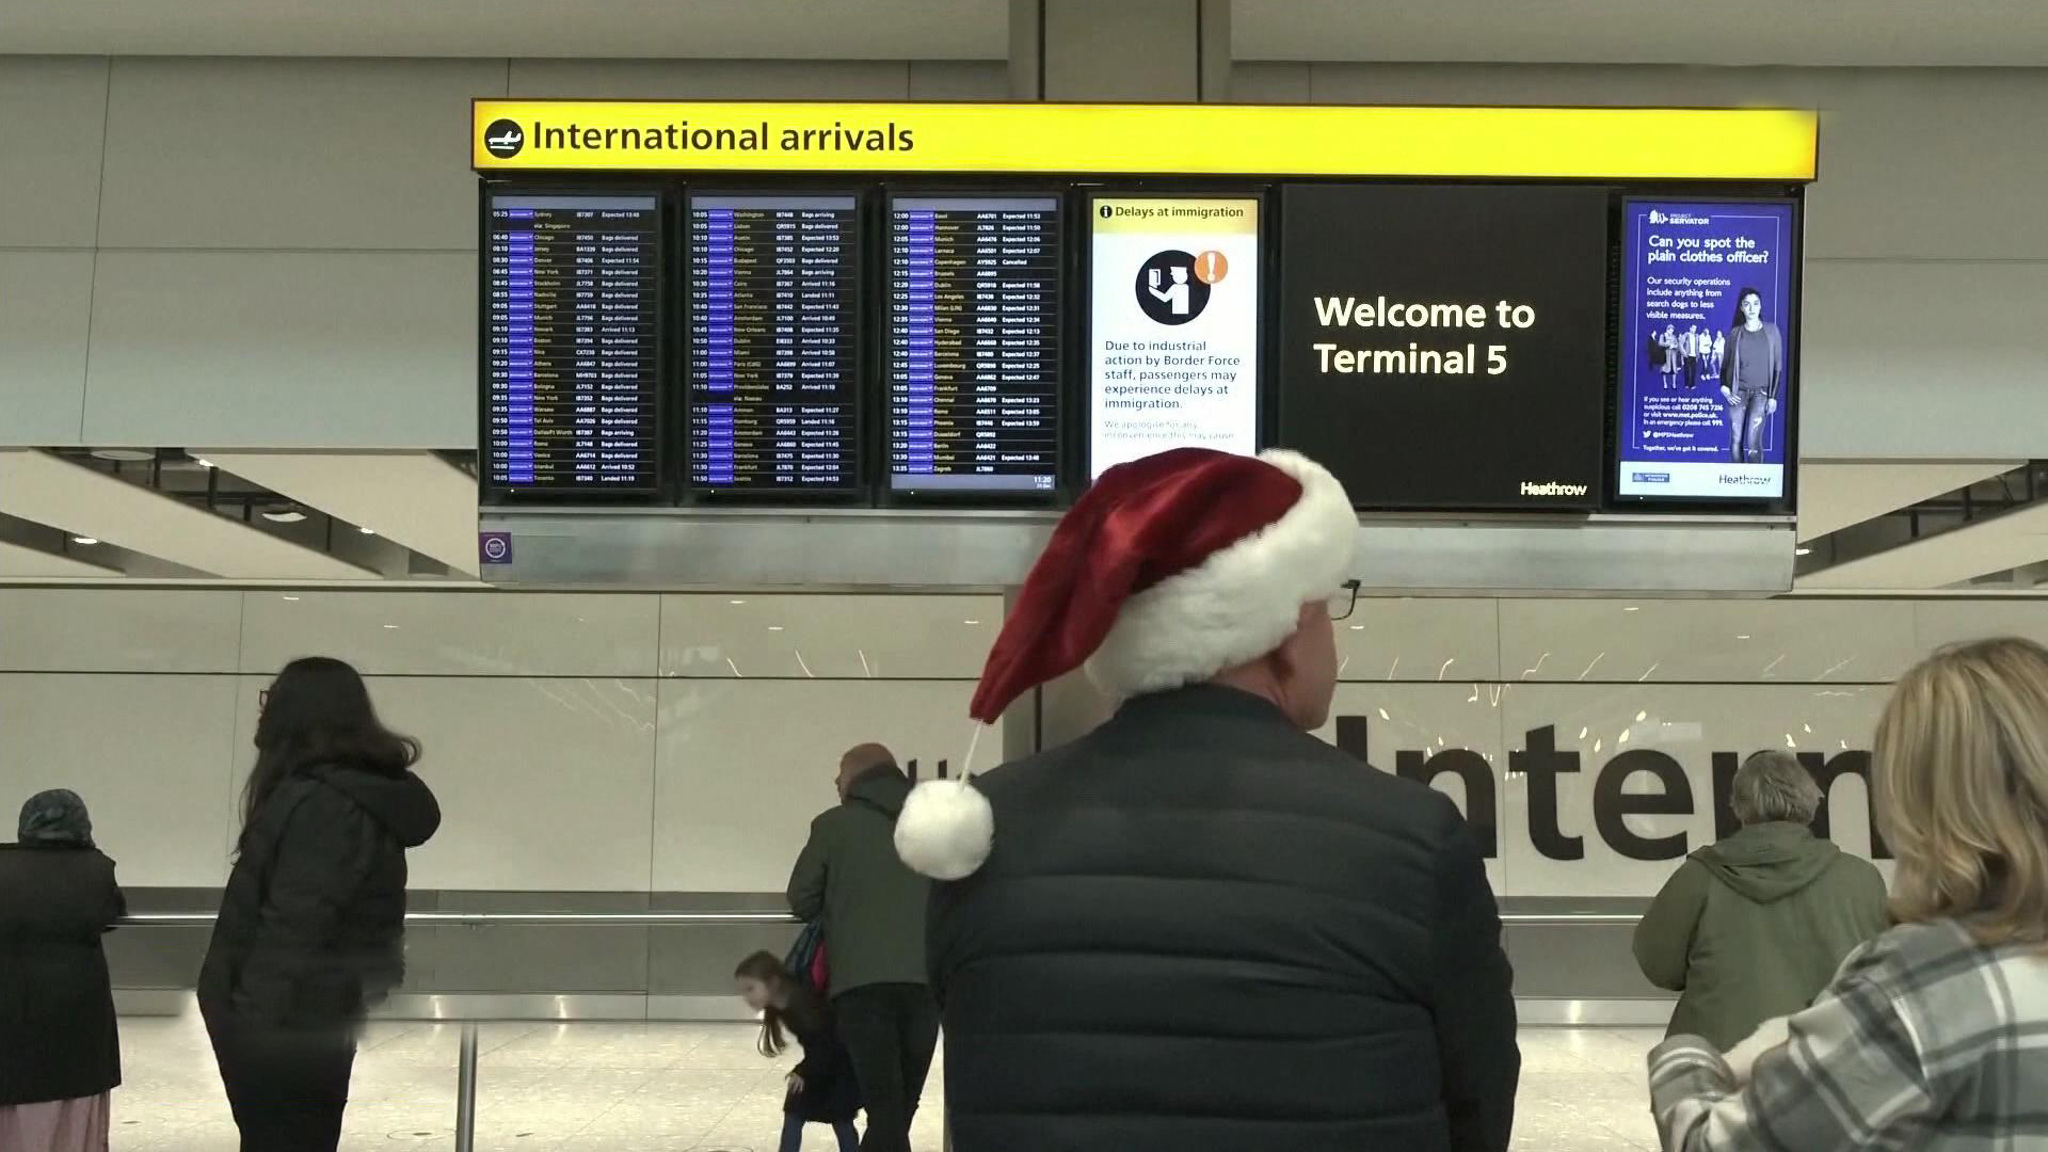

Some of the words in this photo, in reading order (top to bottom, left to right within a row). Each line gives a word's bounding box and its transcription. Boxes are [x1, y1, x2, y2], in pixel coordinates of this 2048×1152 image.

[534, 121, 768, 150] International
[781, 122, 914, 150] arrivals
[1115, 206, 1154, 219] Delays
[1157, 208, 1169, 216] at
[1171, 206, 1244, 219] immigration
[1648, 235, 1673, 248] Can
[1676, 238, 1700, 250] you
[1704, 237, 1732, 250] spot
[1735, 236, 1756, 248] the
[1648, 249, 1676, 264] plain
[1680, 250, 1723, 262] clothes
[1726, 250, 1769, 264] officer?
[1647, 276, 1662, 285] Our
[1664, 277, 1692, 286] security
[1694, 277, 1731, 287] operations
[1646, 288, 1672, 296] include
[1674, 288, 1704, 298] anything
[1705, 288, 1722, 297] from
[1646, 300, 1670, 308] search
[1671, 300, 1688, 310] dogs
[1700, 300, 1714, 308] less
[1314, 296, 1486, 328] Welcome
[1496, 300, 1536, 328] to
[1646, 311, 1668, 319] visible
[1105, 340, 1130, 350] Due
[1133, 342, 1145, 350] to
[1149, 340, 1206, 350] industrial
[1105, 355, 1142, 366] action
[1146, 355, 1160, 367] by
[1164, 355, 1205, 366] Border
[1208, 356, 1241, 366] Force
[1313, 343, 1475, 374] Terminal
[1487, 345, 1507, 375] 5
[1104, 370, 1136, 380] staff,
[1139, 370, 1208, 382] passengers
[1211, 372, 1237, 382] may
[1104, 384, 1171, 396] experience
[1174, 384, 1214, 396] delays
[1216, 385, 1228, 394] at
[1105, 398, 1183, 411] immigration.
[1692, 396, 1713, 404] anything
[1718, 474, 1771, 485] Heathrow
[1520, 482, 1587, 496] Heathrow
